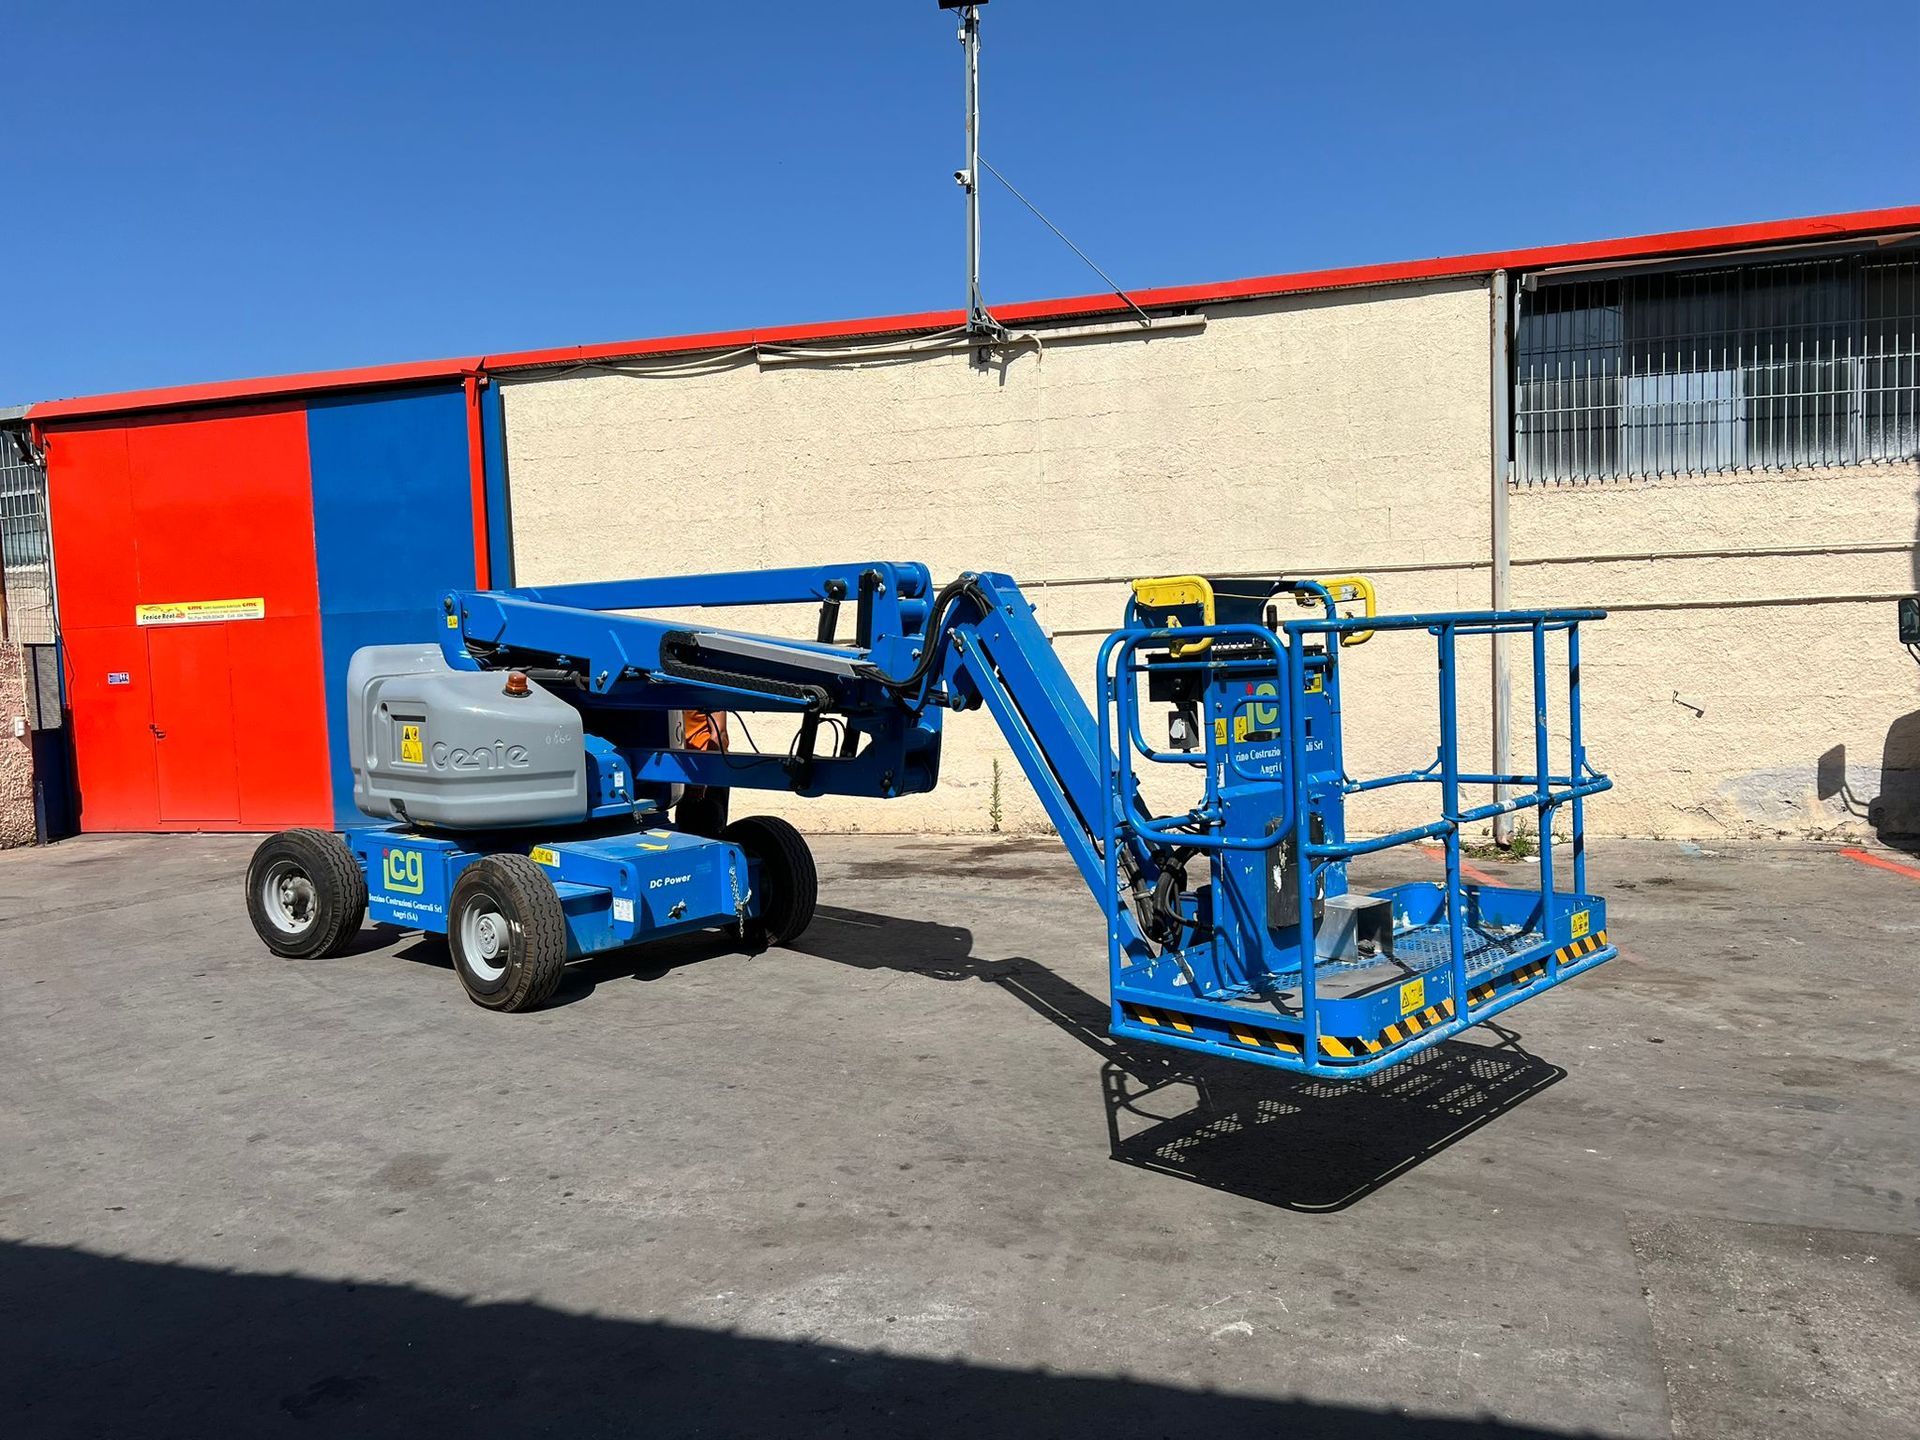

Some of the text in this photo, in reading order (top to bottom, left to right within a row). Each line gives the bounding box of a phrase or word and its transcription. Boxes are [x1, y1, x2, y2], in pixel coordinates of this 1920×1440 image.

[431, 739, 529, 771] Genie
[1260, 762, 1278, 778] Angri
[649, 873, 692, 889] DC Power
